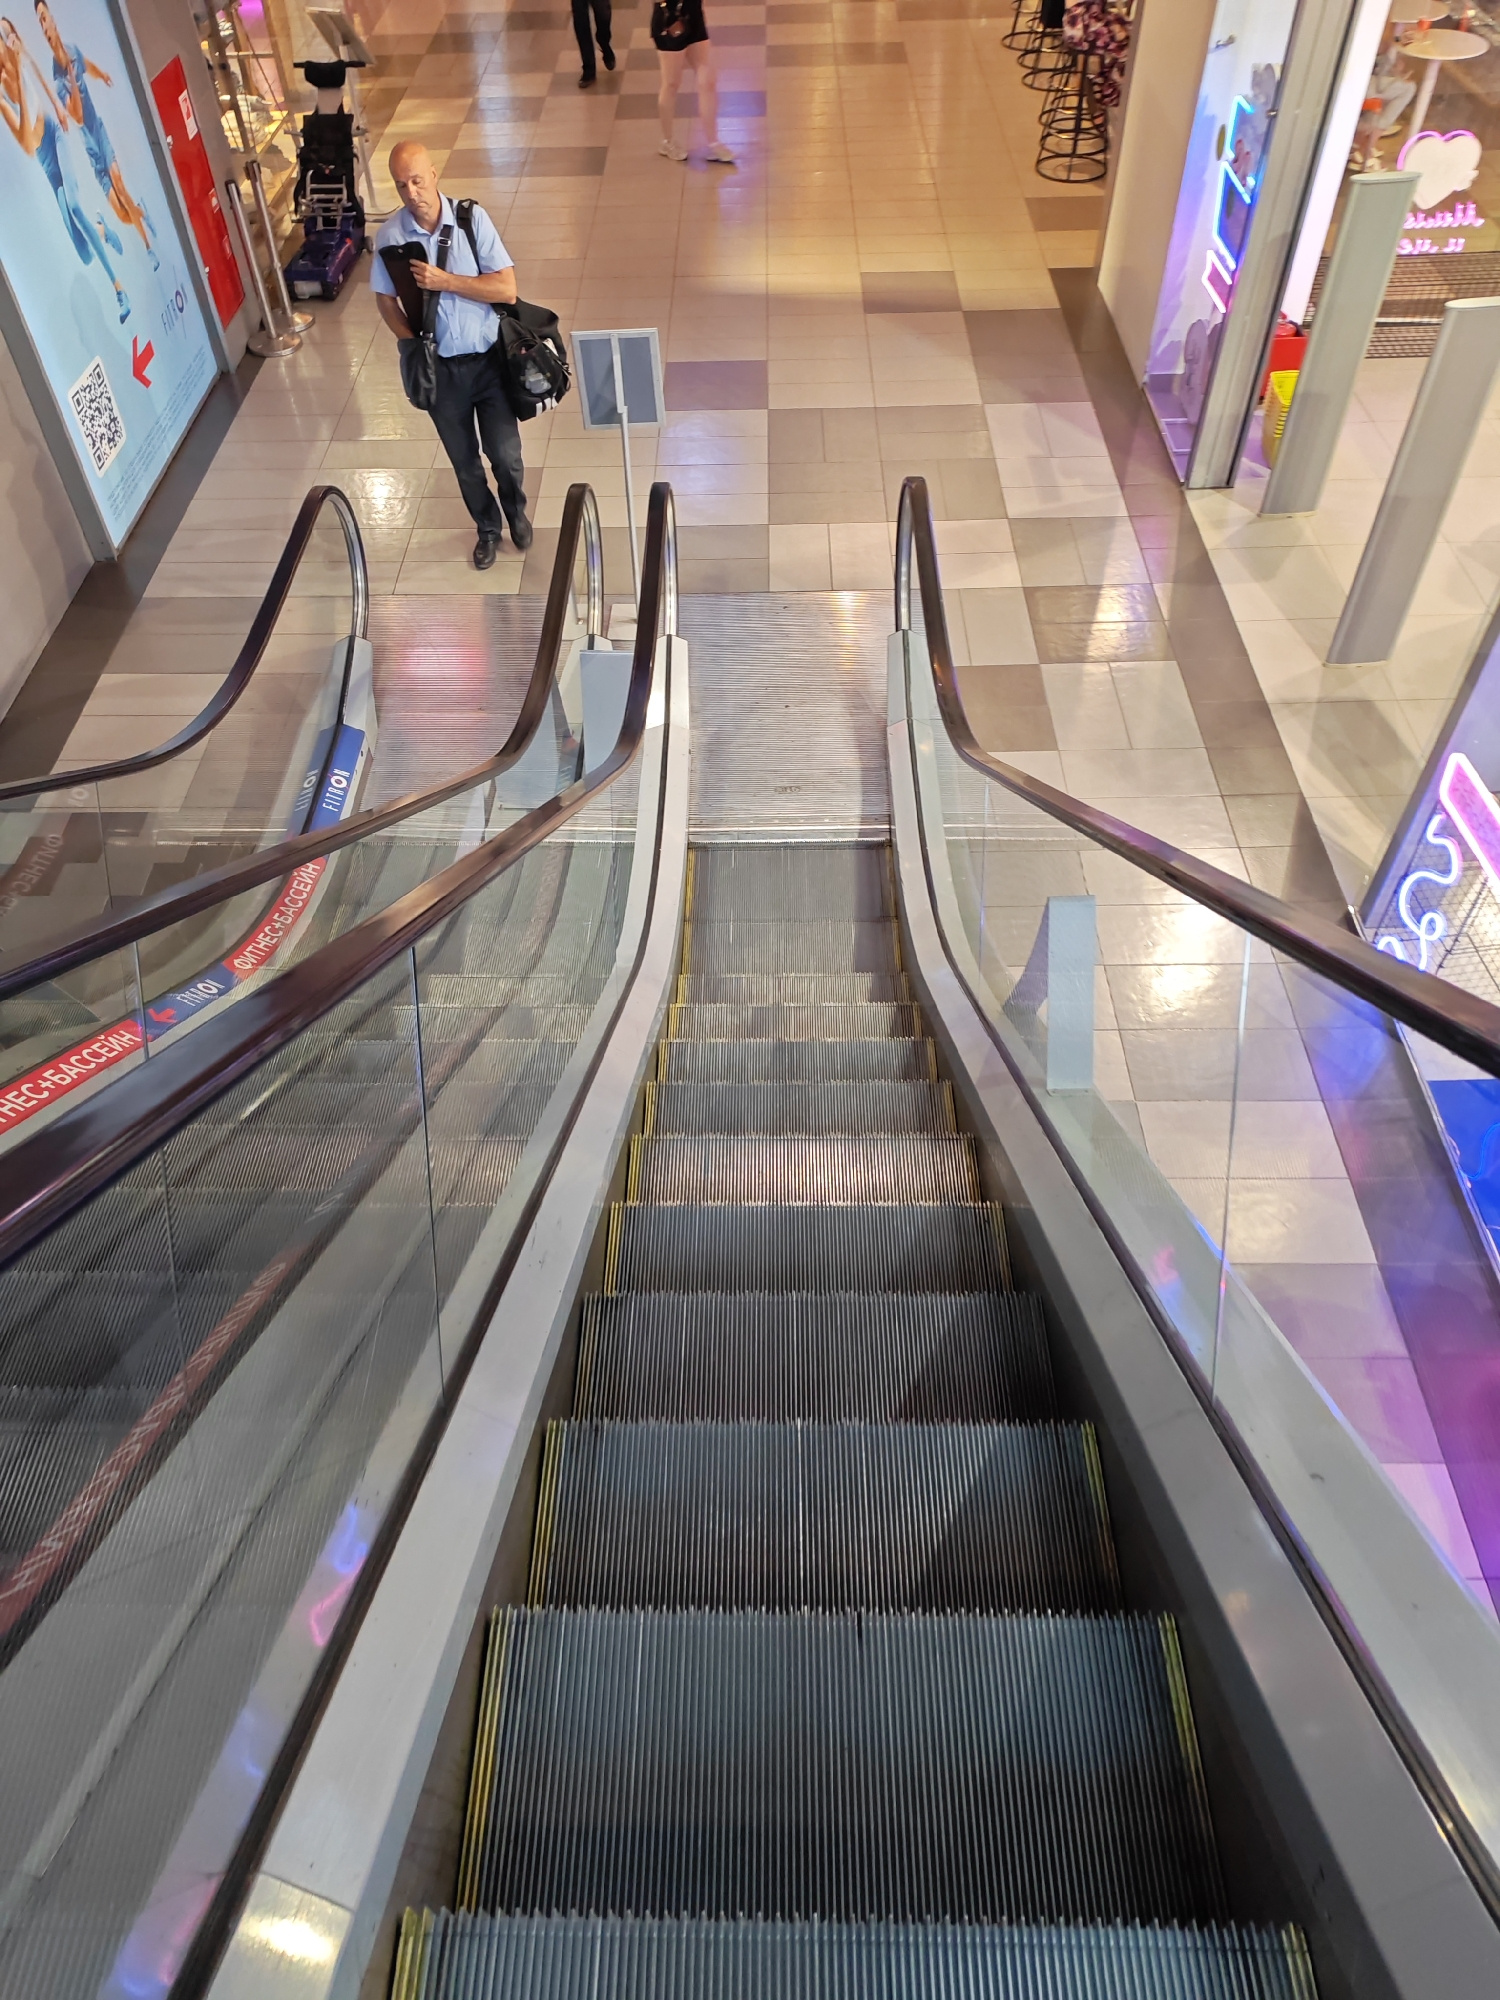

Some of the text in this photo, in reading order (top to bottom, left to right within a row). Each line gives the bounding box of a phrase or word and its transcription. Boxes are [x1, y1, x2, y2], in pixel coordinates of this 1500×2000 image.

[161, 282, 188, 337] FITRON
[322, 768, 350, 812] FITRON
[233, 861, 321, 970] ФИТНЕС+БАССЕЙН
